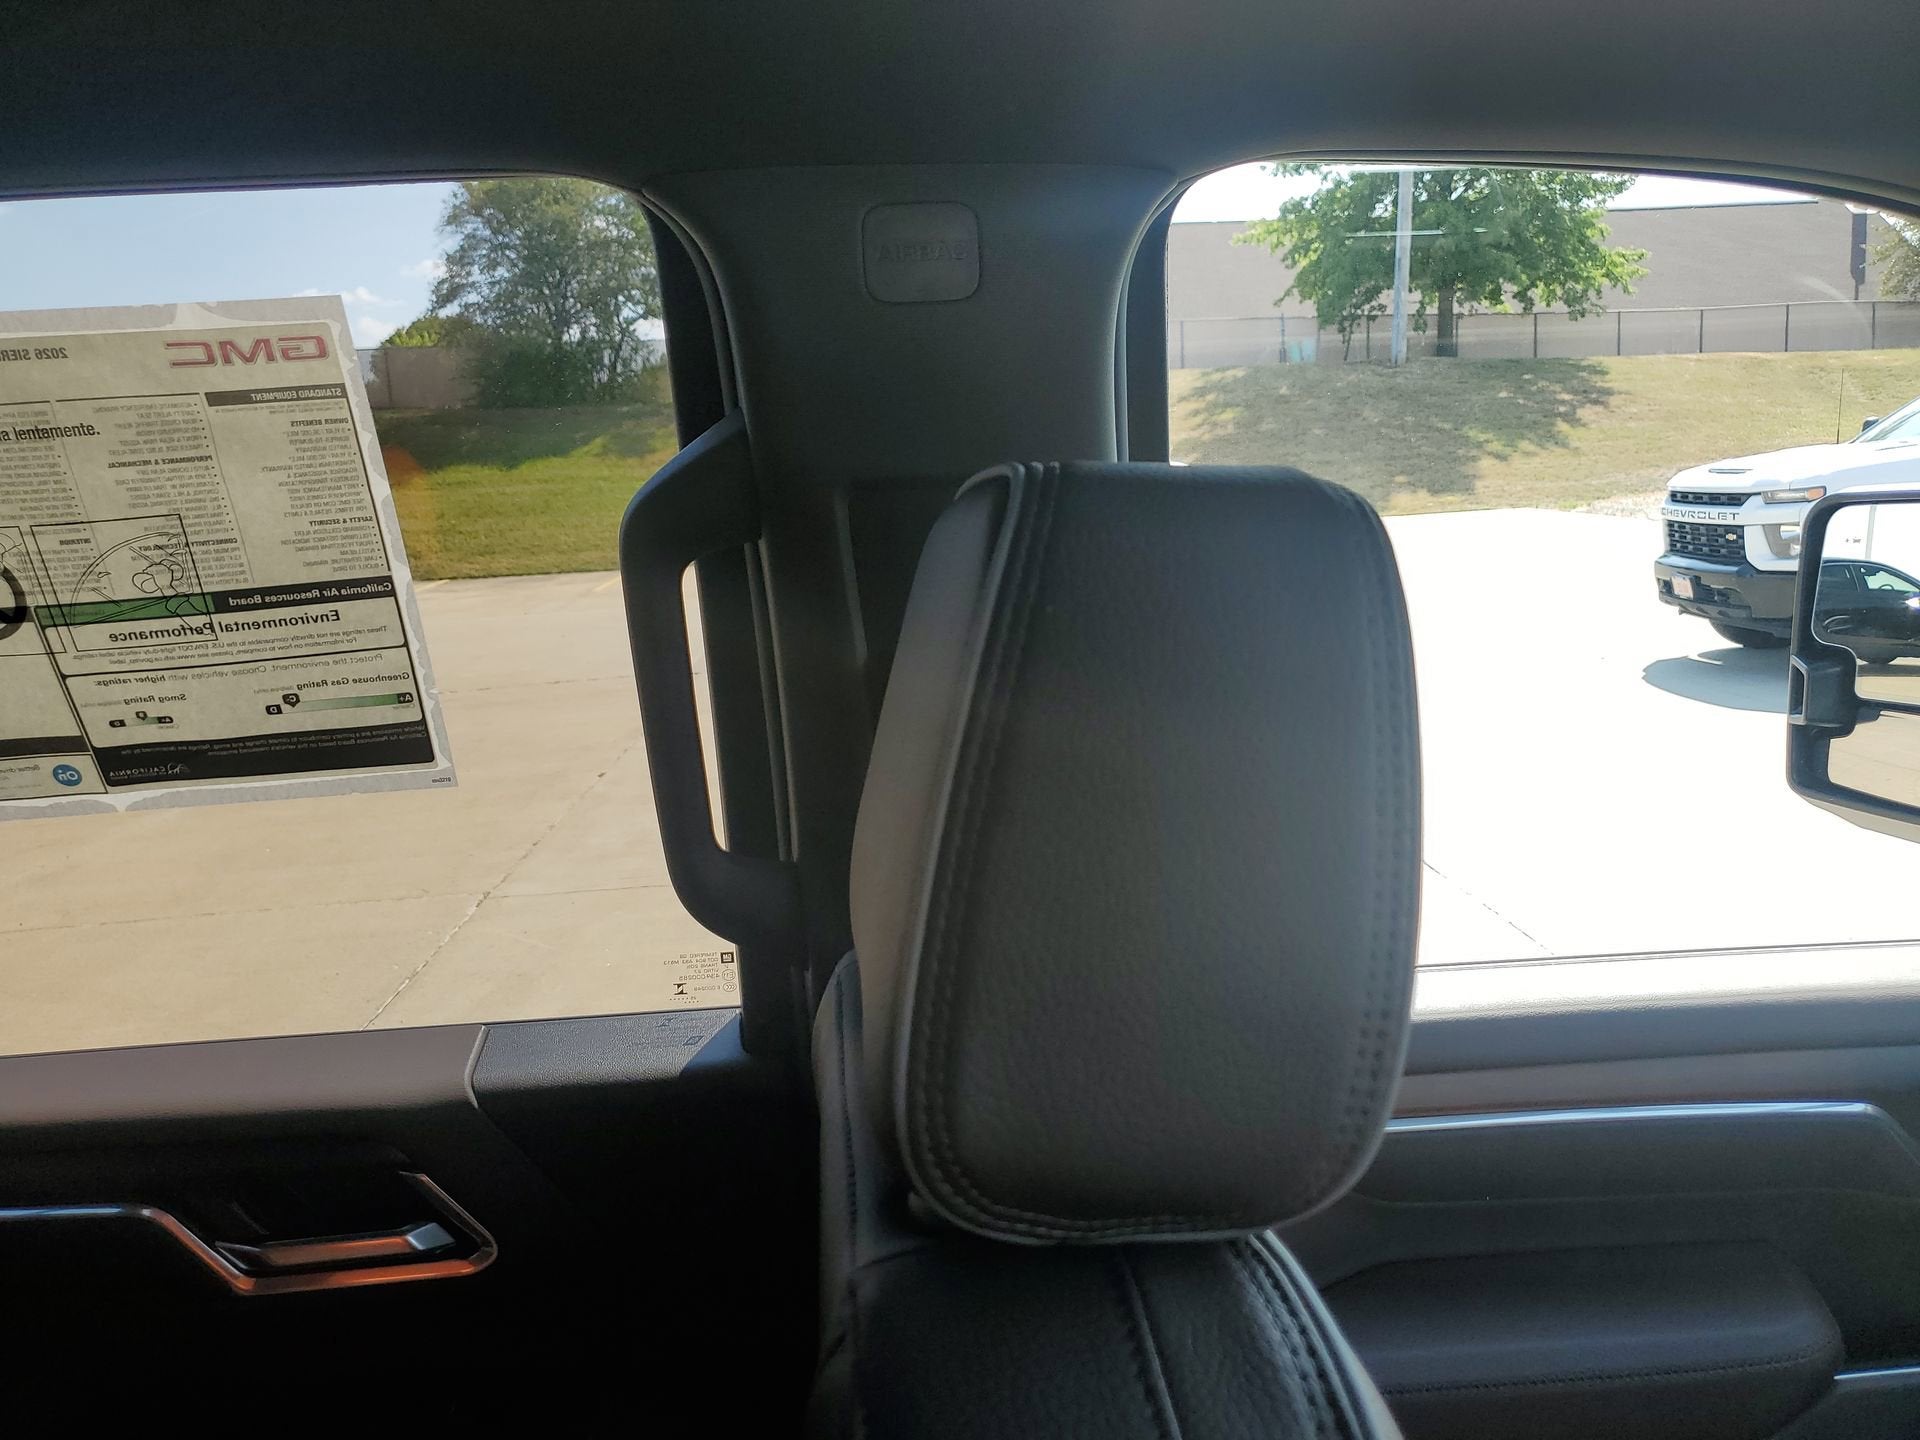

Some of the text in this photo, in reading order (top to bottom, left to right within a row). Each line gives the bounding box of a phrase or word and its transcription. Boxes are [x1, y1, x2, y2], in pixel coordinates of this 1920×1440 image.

[0, 430, 12, 441] a
[12, 422, 101, 441] lentamente.
[1661, 507, 1740, 521] CHEVROLET
